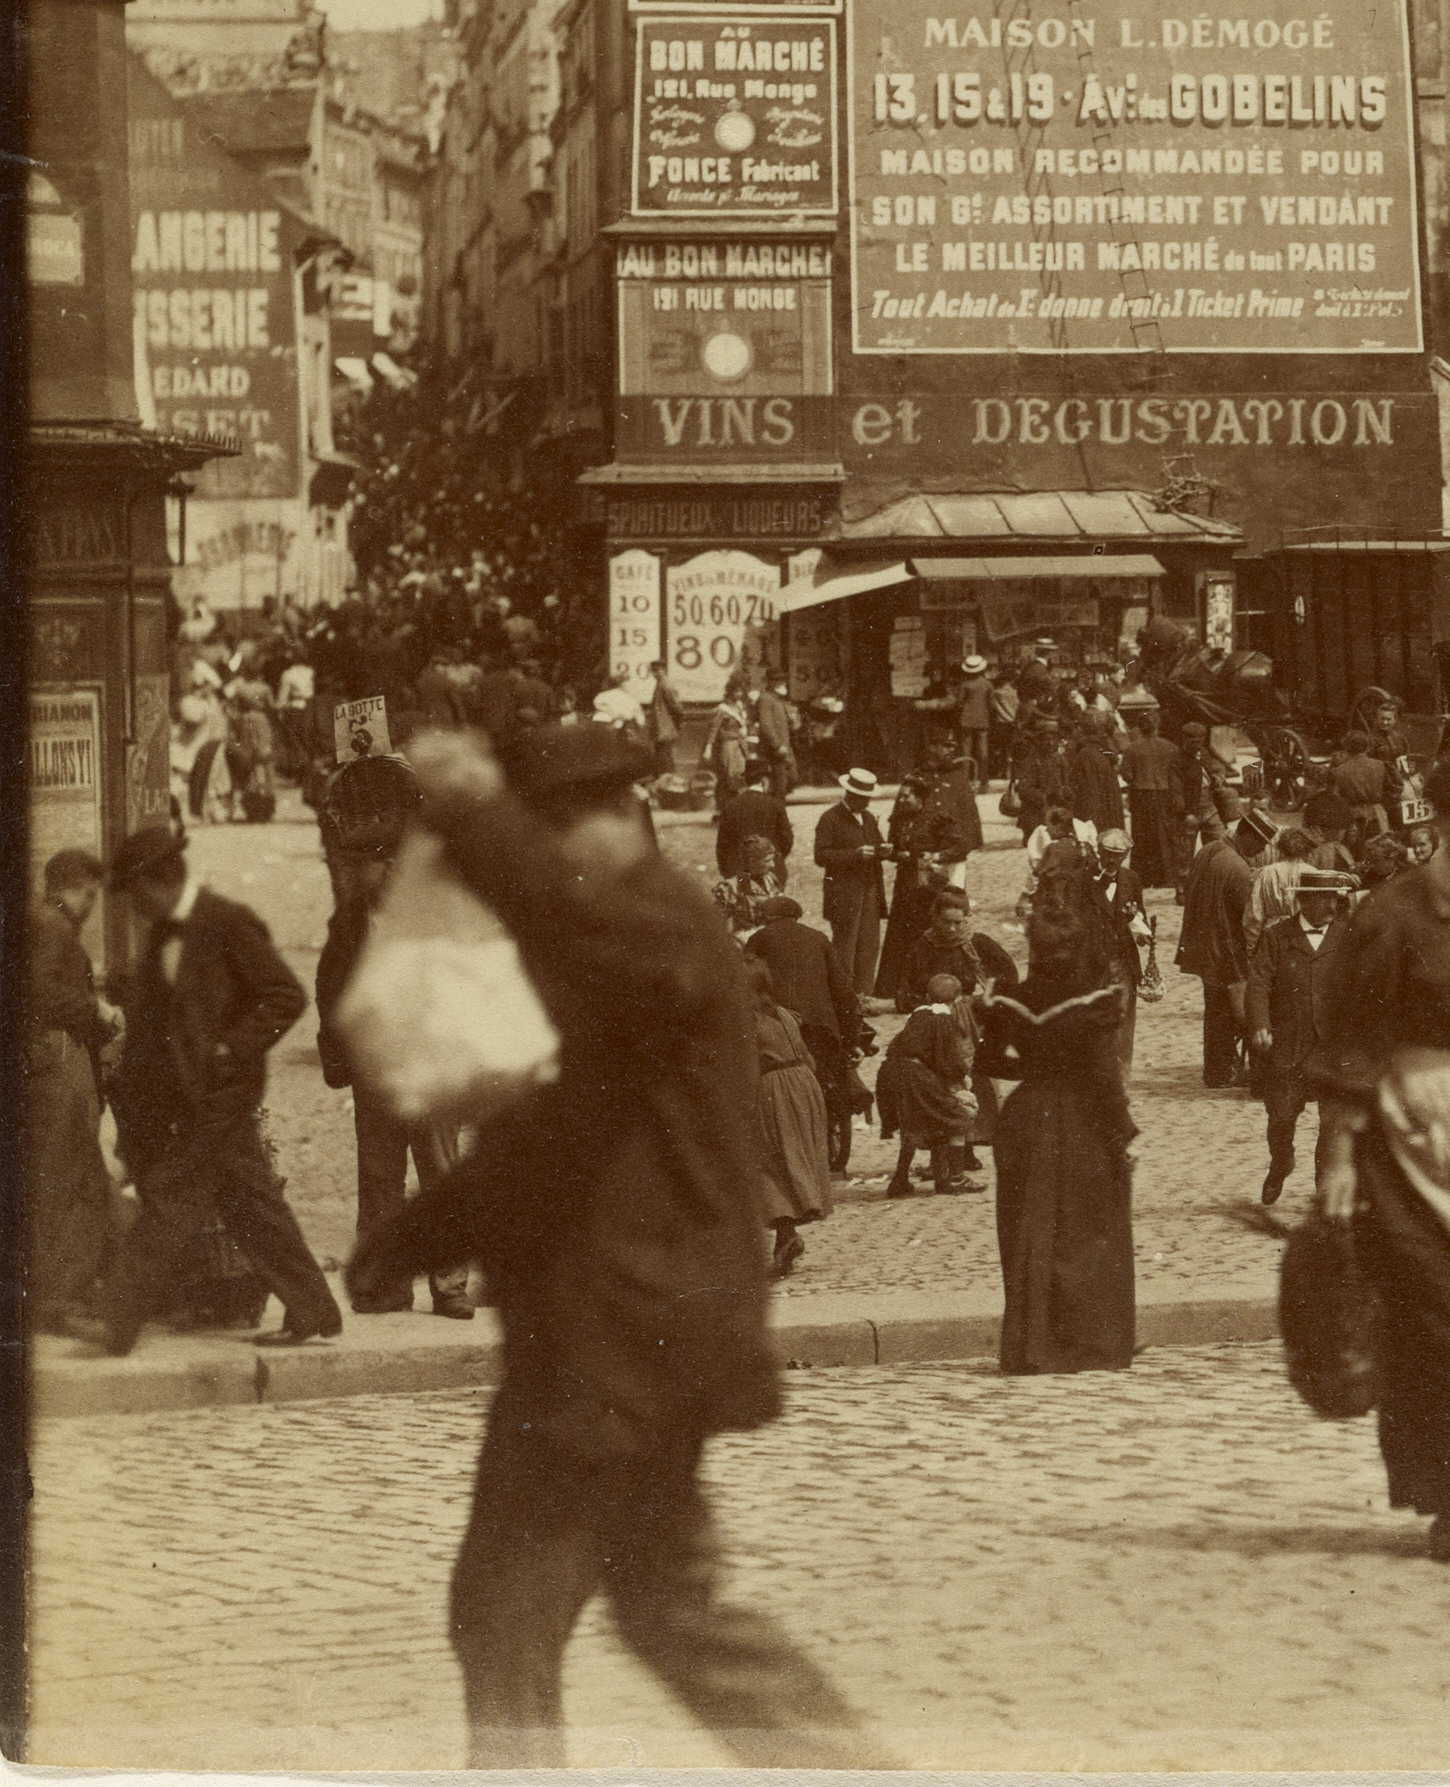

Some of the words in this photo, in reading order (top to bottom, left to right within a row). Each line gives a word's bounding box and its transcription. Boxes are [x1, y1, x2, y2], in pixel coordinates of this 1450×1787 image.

[720, 26, 751, 39] AU
[922, 18, 1097, 48] MAISON
[650, 39, 704, 72] BON
[714, 36, 825, 72] MARCHÉ
[696, 78, 737, 99] Rue
[744, 79, 818, 106] Monge
[1169, 73, 1388, 127] GOBELINS
[880, 150, 1015, 175] MAISON
[1034, 144, 1284, 175] RECOMMANDÉE
[1301, 151, 1385, 175] POUR
[872, 197, 936, 226] SON
[991, 196, 1202, 225] ASSORTIMENT
[1213, 197, 1247, 225] ET
[1259, 190, 1393, 226] VENDANT
[621, 244, 655, 277] AU
[664, 245, 718, 277] BON
[896, 243, 929, 272] LE
[942, 242, 1085, 271] MEILLEUR
[1097, 236, 1220, 271] MARCHÉ
[1223, 249, 1245, 271] de
[1249, 249, 1285, 271] tout
[1287, 242, 1376, 272] PARIS
[685, 287, 725, 310] RUE
[733, 287, 796, 311] MONGE
[872, 289, 926, 319] Tout
[926, 289, 999, 318] Achat
[1037, 291, 1104, 319] donne
[1109, 290, 1163, 319] droit
[1187, 288, 1246, 319] Ticket
[1246, 288, 1305, 318] Prime
[652, 397, 795, 446] VINS
[851, 402, 923, 444] et
[971, 397, 1396, 447] DEGUSTATION
[619, 595, 650, 613] 10
[674, 595, 704, 627] 50
[709, 595, 741, 627] 60
[619, 628, 648, 647] 15
[675, 635, 735, 670] 80
[335, 706, 346, 720] LA
[348, 697, 383, 716] BOTTE
